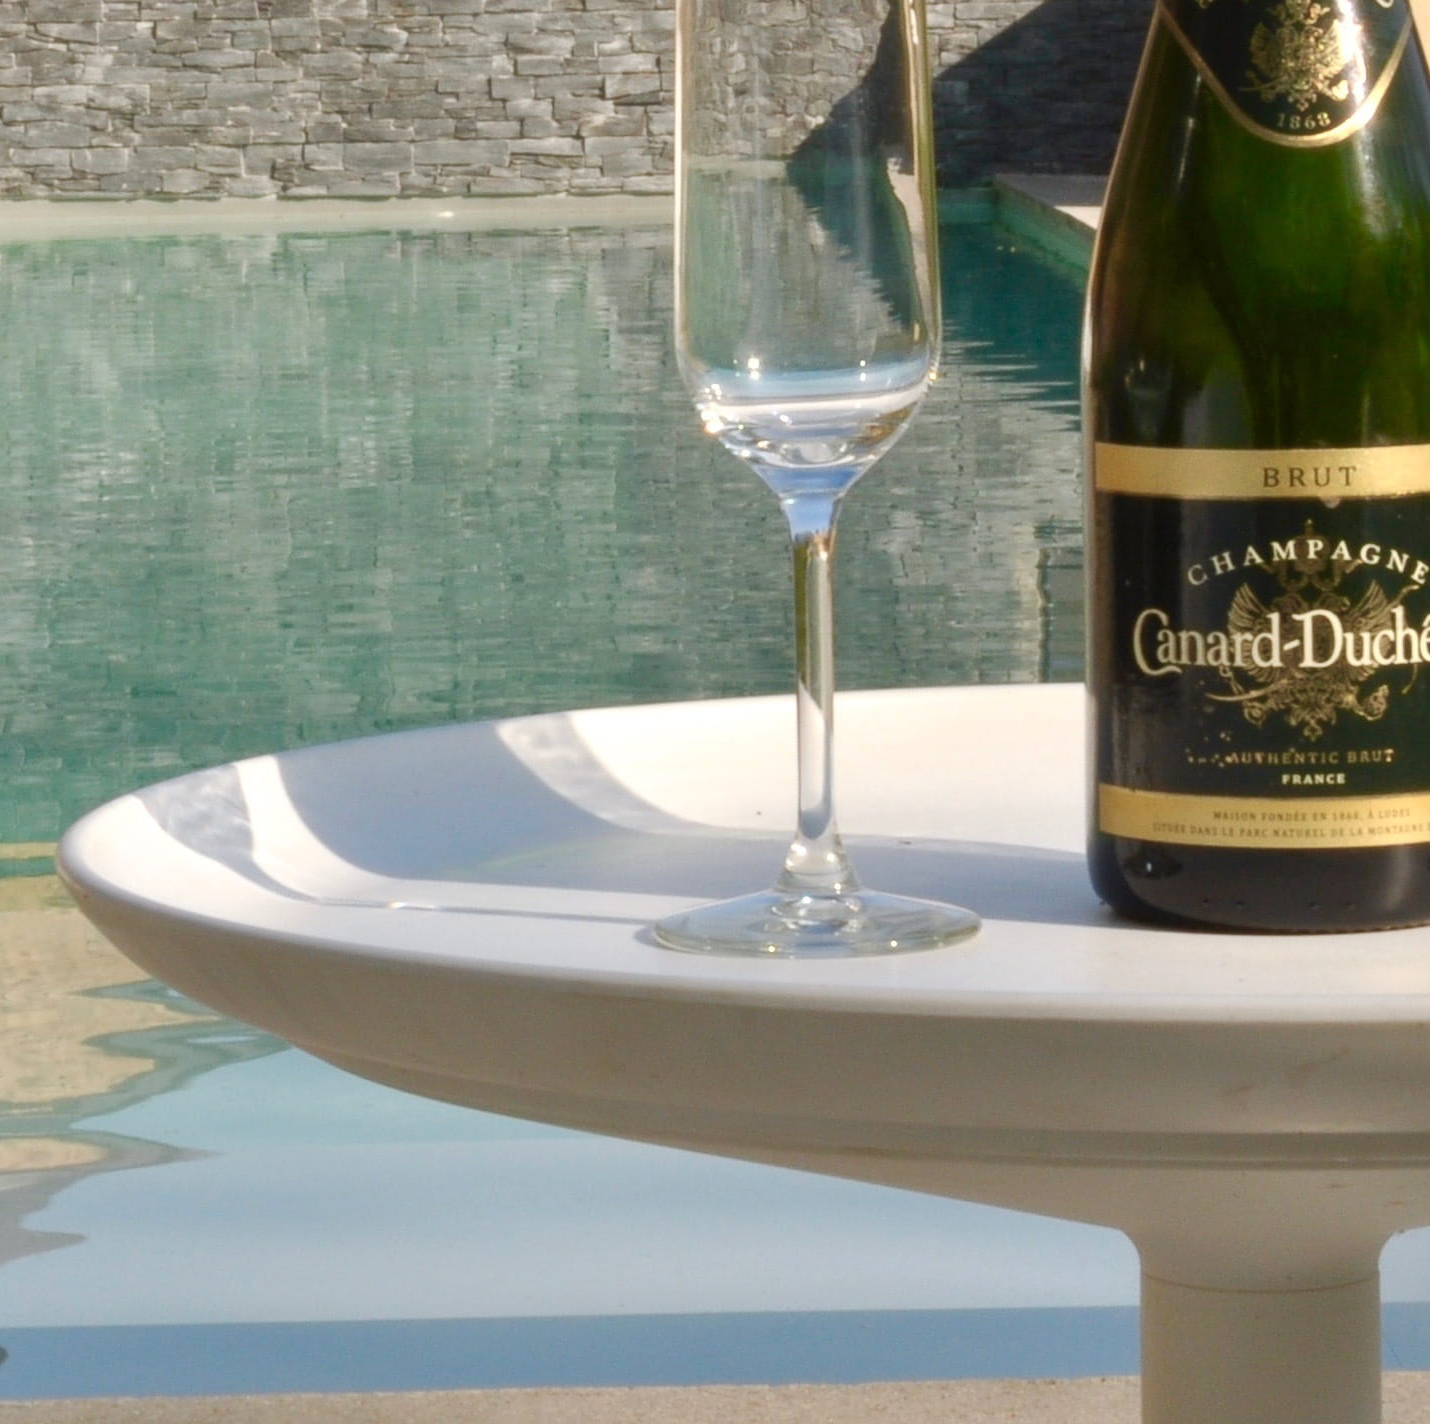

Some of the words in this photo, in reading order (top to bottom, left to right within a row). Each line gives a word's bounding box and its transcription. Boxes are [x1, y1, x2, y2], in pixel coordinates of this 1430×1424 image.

[1277, 111, 1332, 130] 1868
[1263, 465, 1356, 488] BRUT
[1187, 539, 1430, 585] CHAMPAGNE
[1229, 750, 1339, 765] AUTHENTIC
[1346, 747, 1394, 764] BRUT
[1281, 772, 1347, 785] FRANCE
[1213, 811, 1257, 821] MAISON
[1238, 828, 1268, 838] PARC
